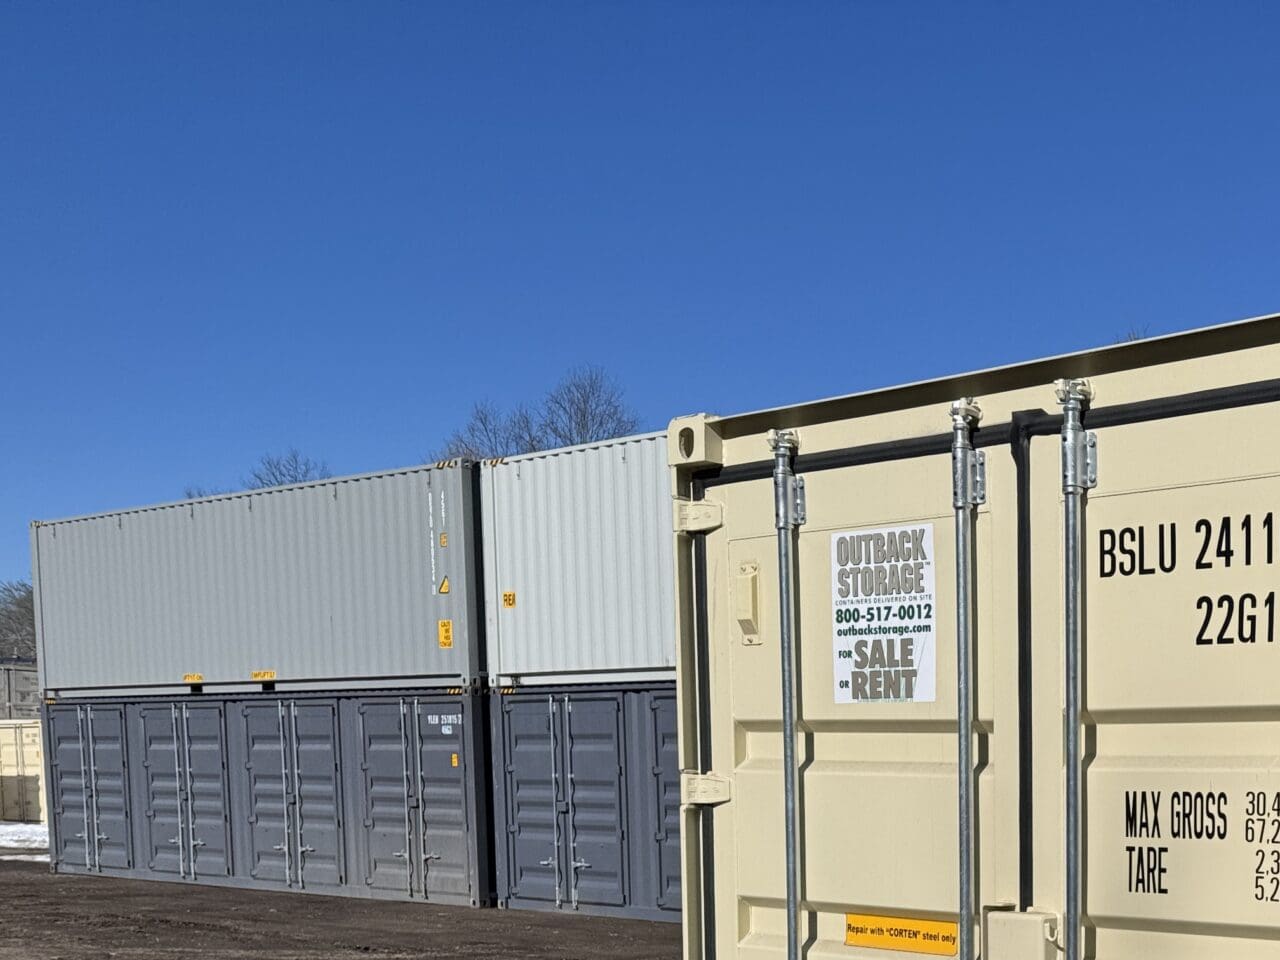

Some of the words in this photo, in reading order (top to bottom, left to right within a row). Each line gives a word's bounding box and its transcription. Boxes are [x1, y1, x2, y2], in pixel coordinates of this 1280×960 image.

[837, 529, 927, 566] OUTBACK
[1099, 523, 1176, 577] BSLU
[838, 562, 925, 598] STORAGE
[835, 598, 872, 606] CONTAINERS
[873, 596, 907, 604] DELIVERED
[835, 603, 932, 623] 800-517-0012
[837, 624, 931, 637] outbackstorage.com
[1195, 592, 1276, 645] 22G1
[838, 650, 853, 659] FOR
[854, 638, 914, 669] SALE
[839, 680, 850, 689] OR
[851, 669, 918, 700] RENT
[1125, 791, 1161, 838] MAX
[1171, 791, 1227, 840] GROSS
[1125, 846, 1169, 894] TARE
[847, 923, 868, 936] Repair
[870, 926, 885, 936] with
[922, 932, 940, 942] steel
[941, 933, 957, 945] only
